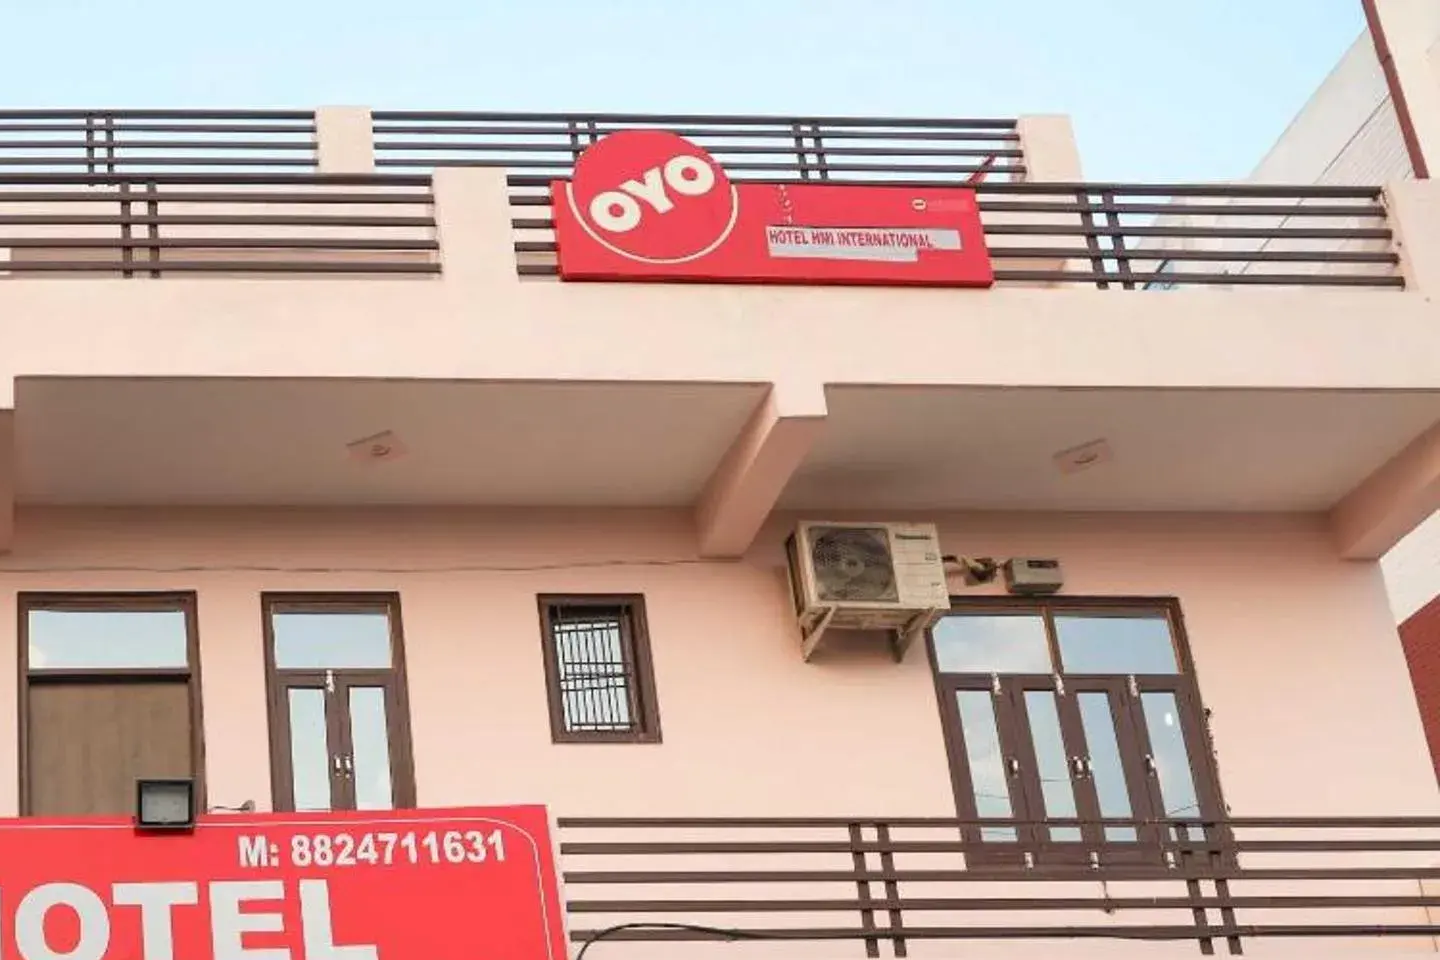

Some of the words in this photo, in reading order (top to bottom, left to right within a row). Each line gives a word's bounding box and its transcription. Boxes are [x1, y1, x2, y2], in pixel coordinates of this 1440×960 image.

[590, 155, 714, 232] OYO
[769, 230, 809, 246] HOTEL
[811, 231, 835, 247] HMI
[837, 232, 933, 248] INTERNATIONAL
[237, 837, 281, 866] M:
[291, 829, 505, 864] 8824711631
